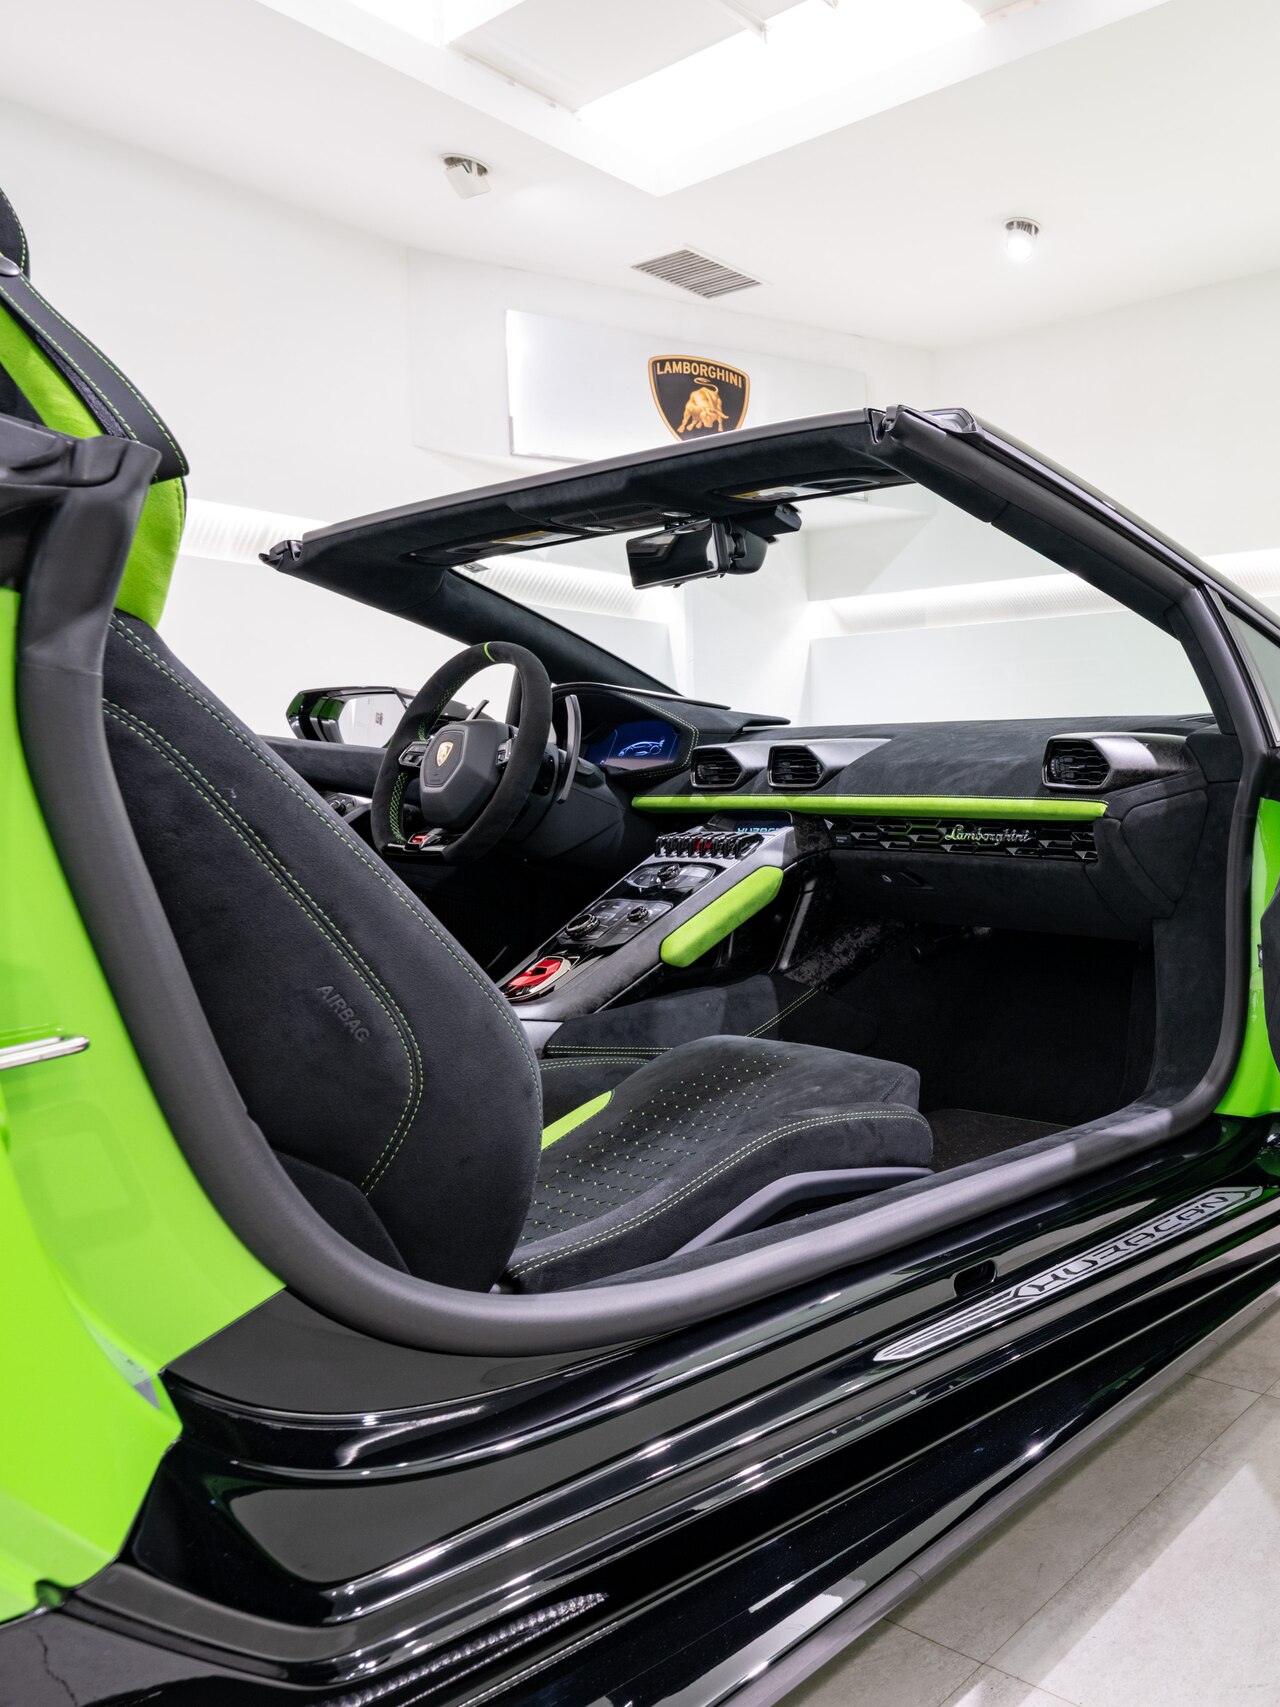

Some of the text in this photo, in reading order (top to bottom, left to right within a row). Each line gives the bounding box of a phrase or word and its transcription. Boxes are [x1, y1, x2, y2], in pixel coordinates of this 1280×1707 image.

[656, 361, 742, 388] LAMBORGHINI
[945, 824, 1032, 845] Lamborghini
[317, 986, 369, 1041] AIRBAG
